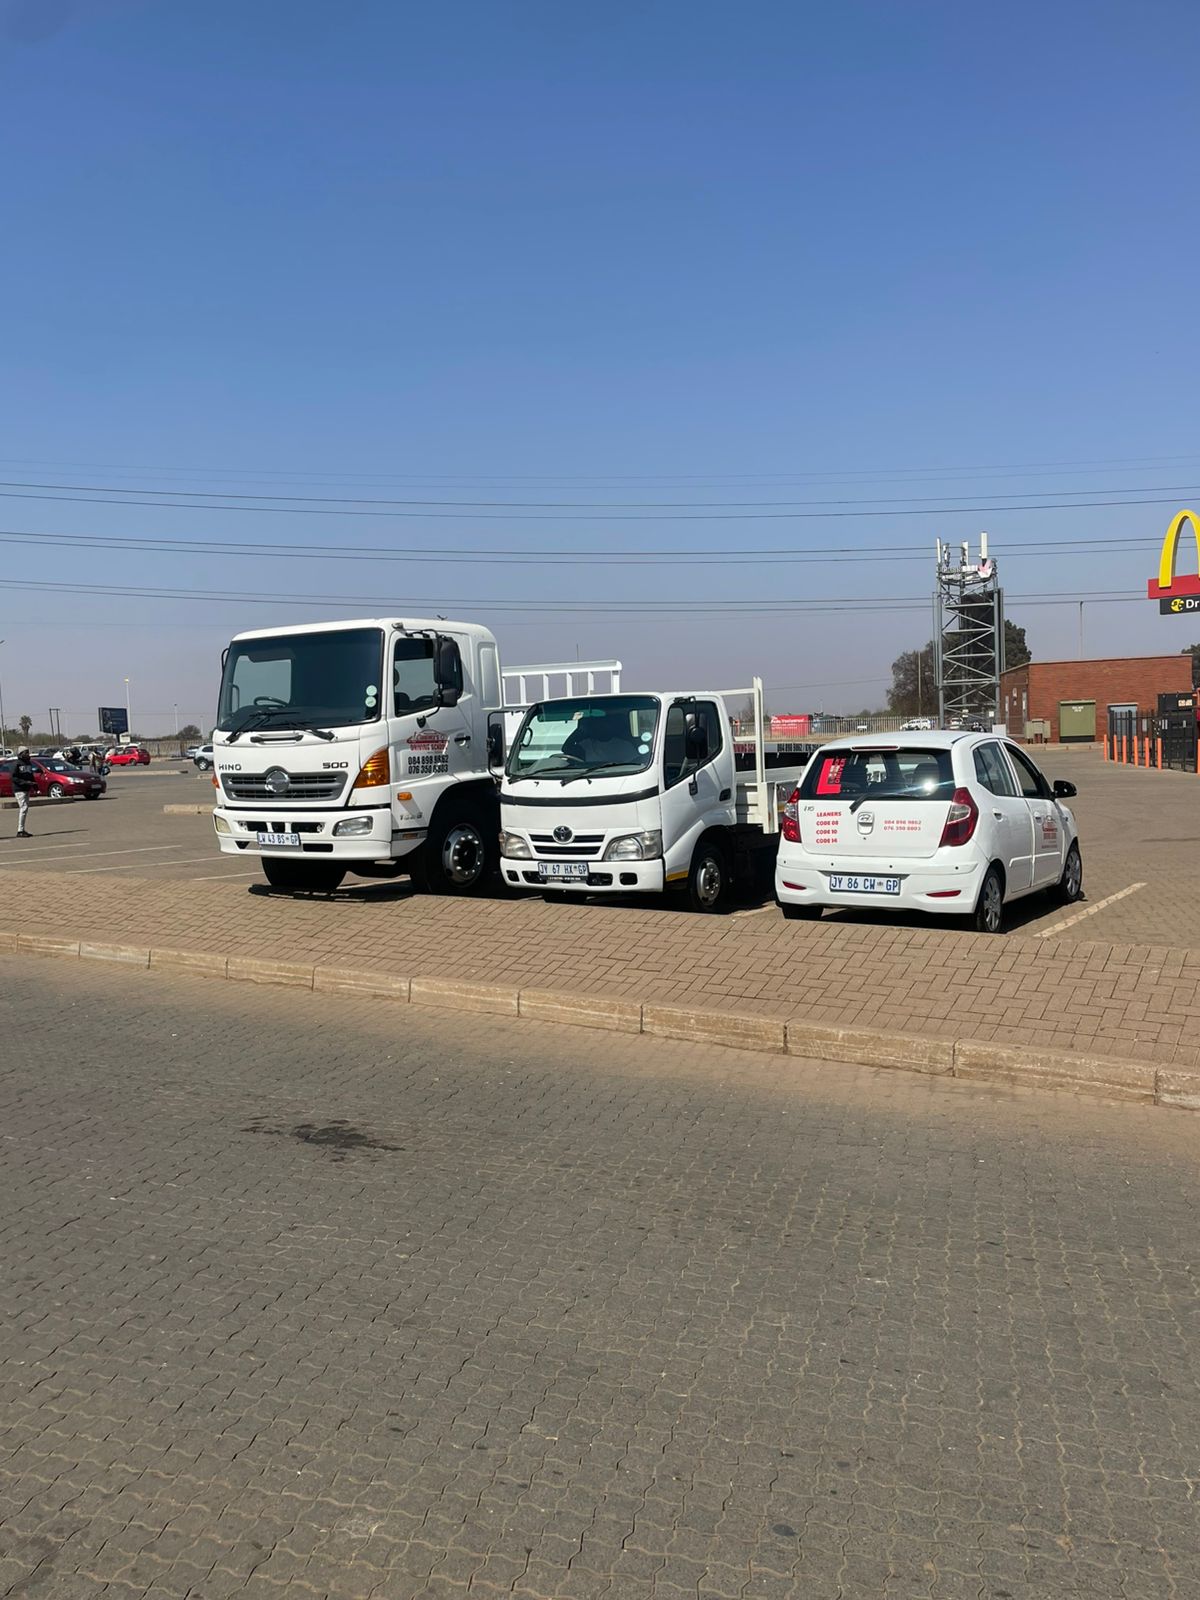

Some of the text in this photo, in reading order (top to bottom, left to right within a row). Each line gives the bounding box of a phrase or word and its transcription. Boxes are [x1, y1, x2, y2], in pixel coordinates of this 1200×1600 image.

[322, 761, 349, 769] 500
[408, 756, 420, 765] 084
[219, 763, 242, 771] HINO
[408, 765, 420, 775] 076
[290, 834, 298, 845] GP
[552, 864, 560, 874] 67
[564, 864, 573, 874] HX
[578, 864, 587, 875] GP
[831, 876, 843, 888] JY
[847, 877, 859, 889] 86
[886, 879, 898, 891] GP
